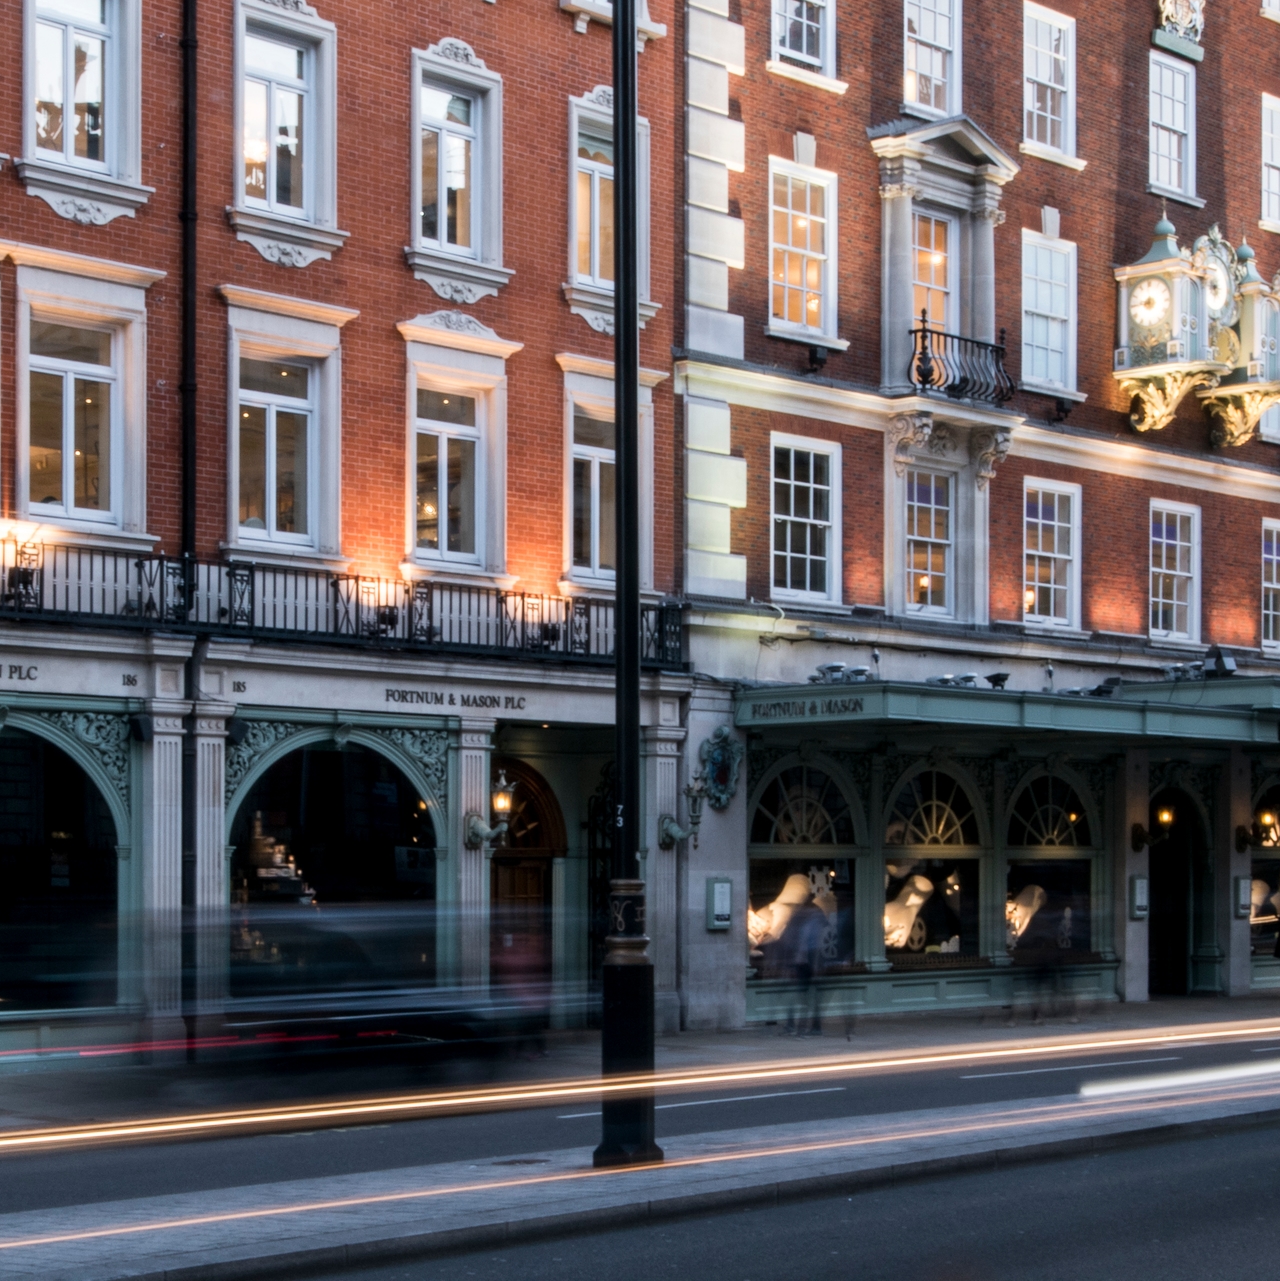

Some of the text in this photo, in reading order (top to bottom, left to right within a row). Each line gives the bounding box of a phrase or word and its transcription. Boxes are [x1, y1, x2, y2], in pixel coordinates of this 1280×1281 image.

[8, 664, 38, 681] PLC
[122, 674, 138, 686] 186
[232, 681, 247, 693] 185
[385, 689, 526, 710] FORTNUM & MASON PLC
[751, 698, 864, 719] FORTNUM & MASON
